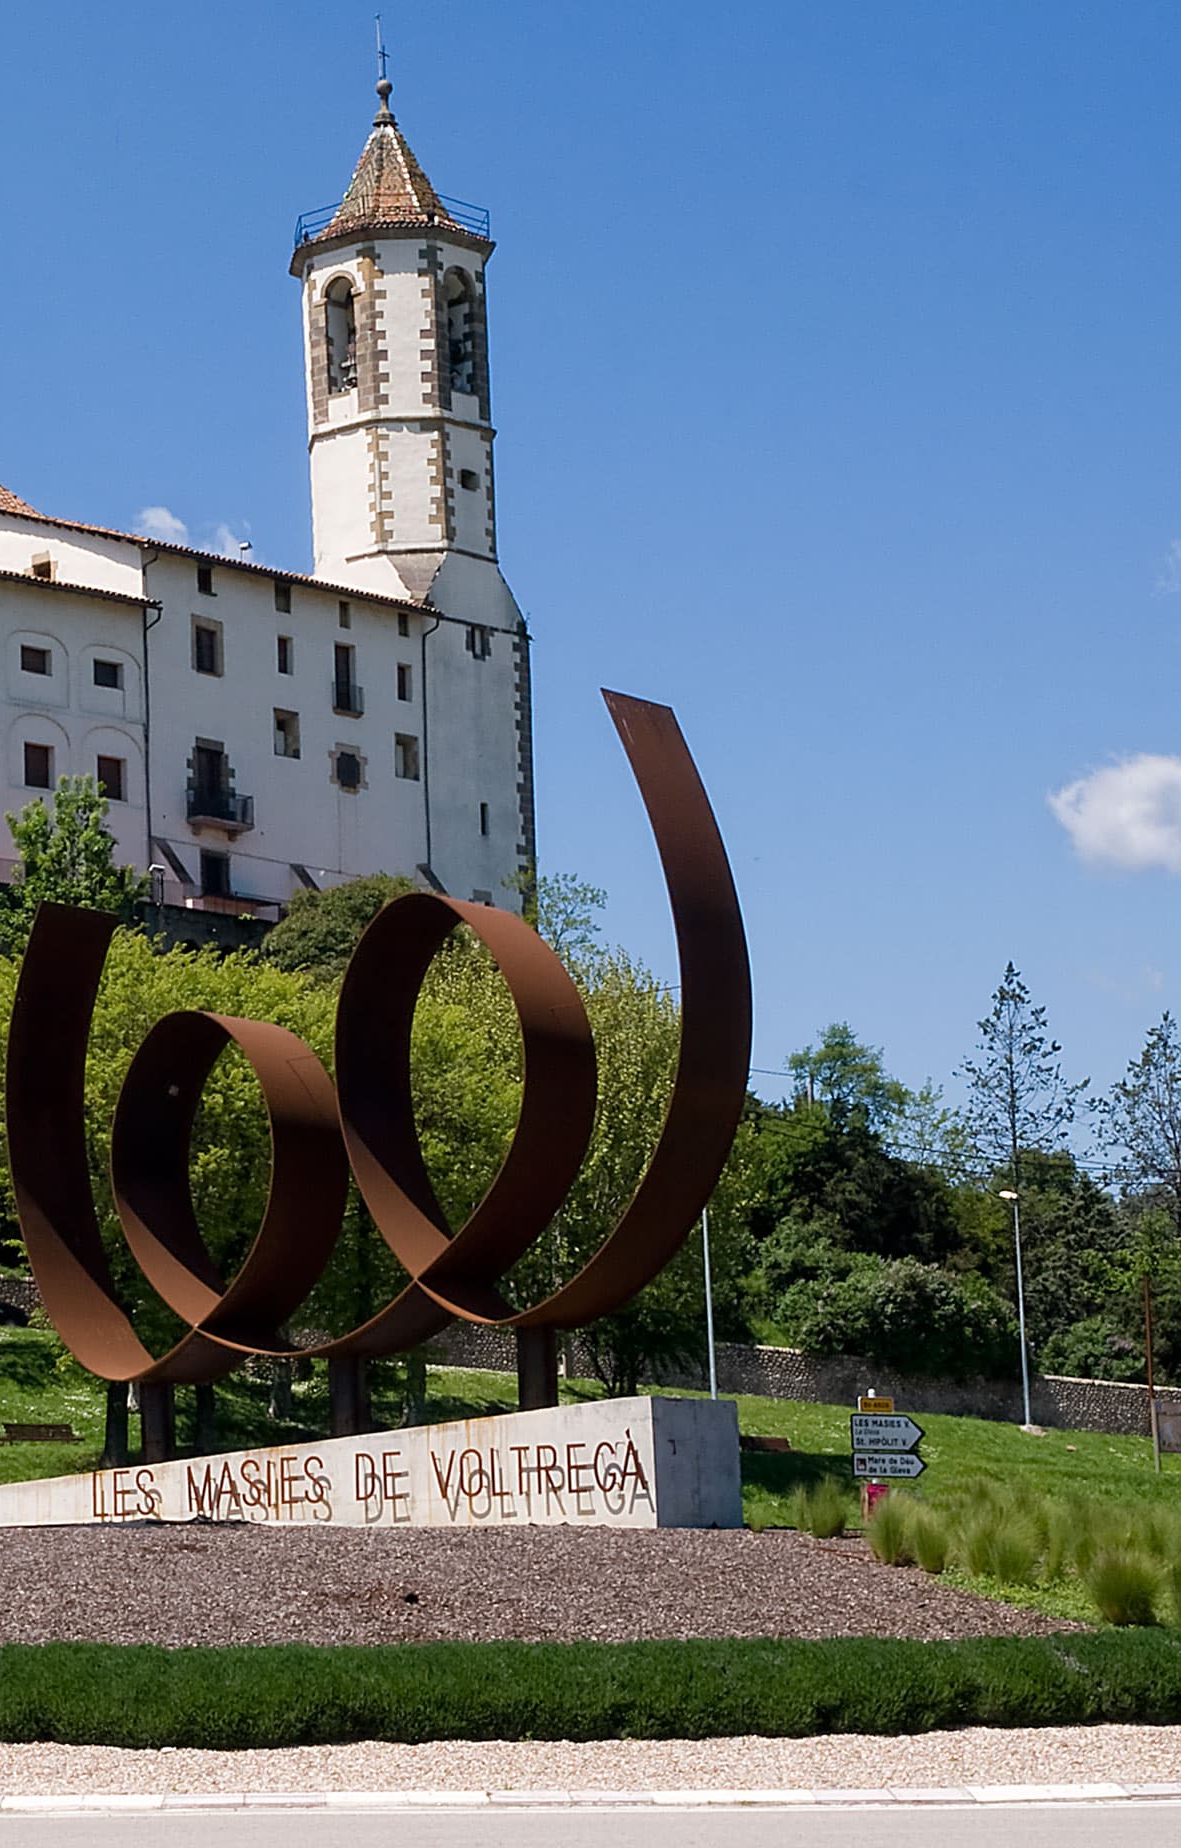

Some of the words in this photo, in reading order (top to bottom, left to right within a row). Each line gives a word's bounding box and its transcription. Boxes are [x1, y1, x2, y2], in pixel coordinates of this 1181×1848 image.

[854, 1418, 869, 1428] LES
[872, 1418, 902, 1428] MASIES
[867, 1456, 886, 1465] Mare
[888, 1457, 898, 1465] de
[92, 1468, 156, 1518] LES
[186, 1455, 324, 1514] MASIES
[355, 1451, 404, 1501] DE
[430, 1427, 648, 1500] VOLTREGÀ
[868, 1466, 877, 1474] de
